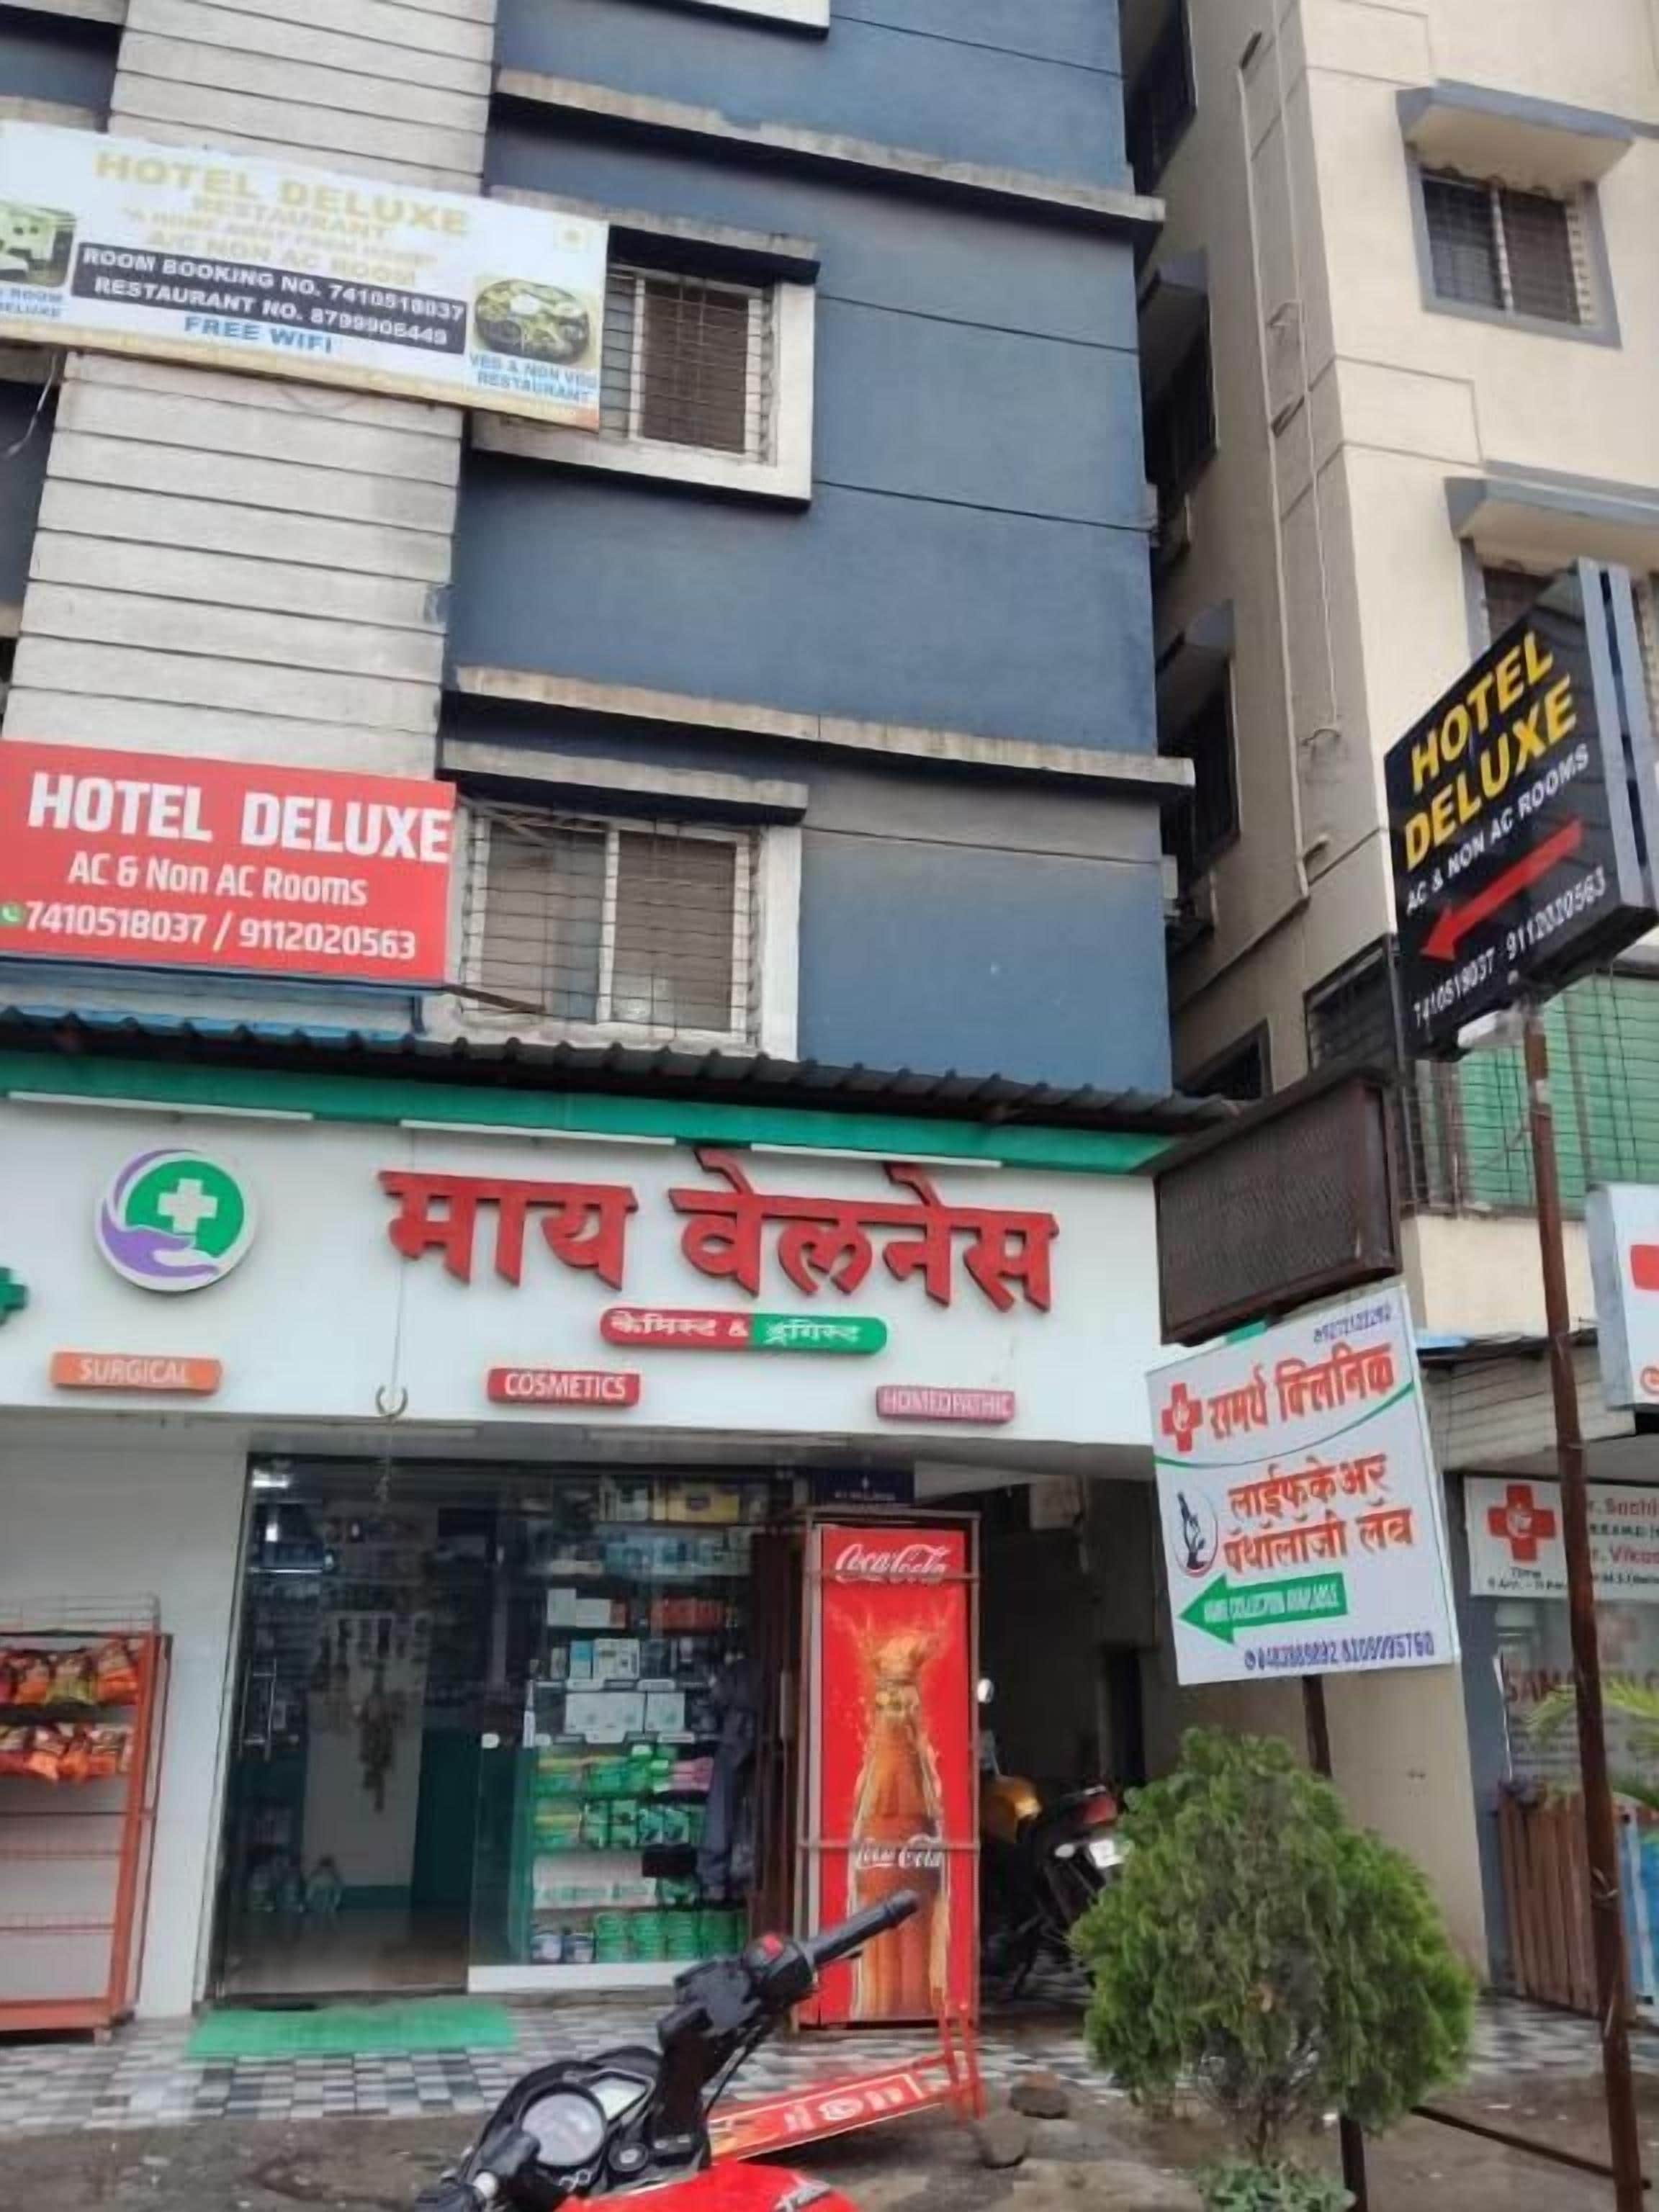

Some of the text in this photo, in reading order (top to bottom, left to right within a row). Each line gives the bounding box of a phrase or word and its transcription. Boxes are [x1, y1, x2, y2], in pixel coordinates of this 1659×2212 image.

[94, 150, 469, 235] HOTEL DELUXE
[82, 247, 156, 273] ROOM
[162, 258, 274, 287] BOOKING
[281, 276, 321, 297] NO.
[94, 276, 256, 315] RESTAURANT
[261, 300, 303, 320] NO.
[184, 315, 332, 354] FREE WIFI
[1410, 631, 1554, 793] HOTEL
[1404, 674, 1578, 873] DELUXE
[29, 770, 453, 863] HOTEL DELUXE
[1407, 880, 1428, 917] AC
[1447, 831, 1485, 878] NON
[1490, 806, 1514, 845] AC
[1517, 742, 1589, 820] ROOMS
[68, 852, 368, 907] AC & Non AC Rooms
[26, 901, 207, 945] 7410518037
[240, 917, 415, 959] 9112020563
[379, 1148, 1060, 1313] माय वेलनेस
[729, 1321, 748, 1338] &
[78, 1359, 187, 1386] SURGICAL
[504, 1372, 626, 1401] COSMETICS
[1274, 1342, 1395, 1423] क्लिनिक
